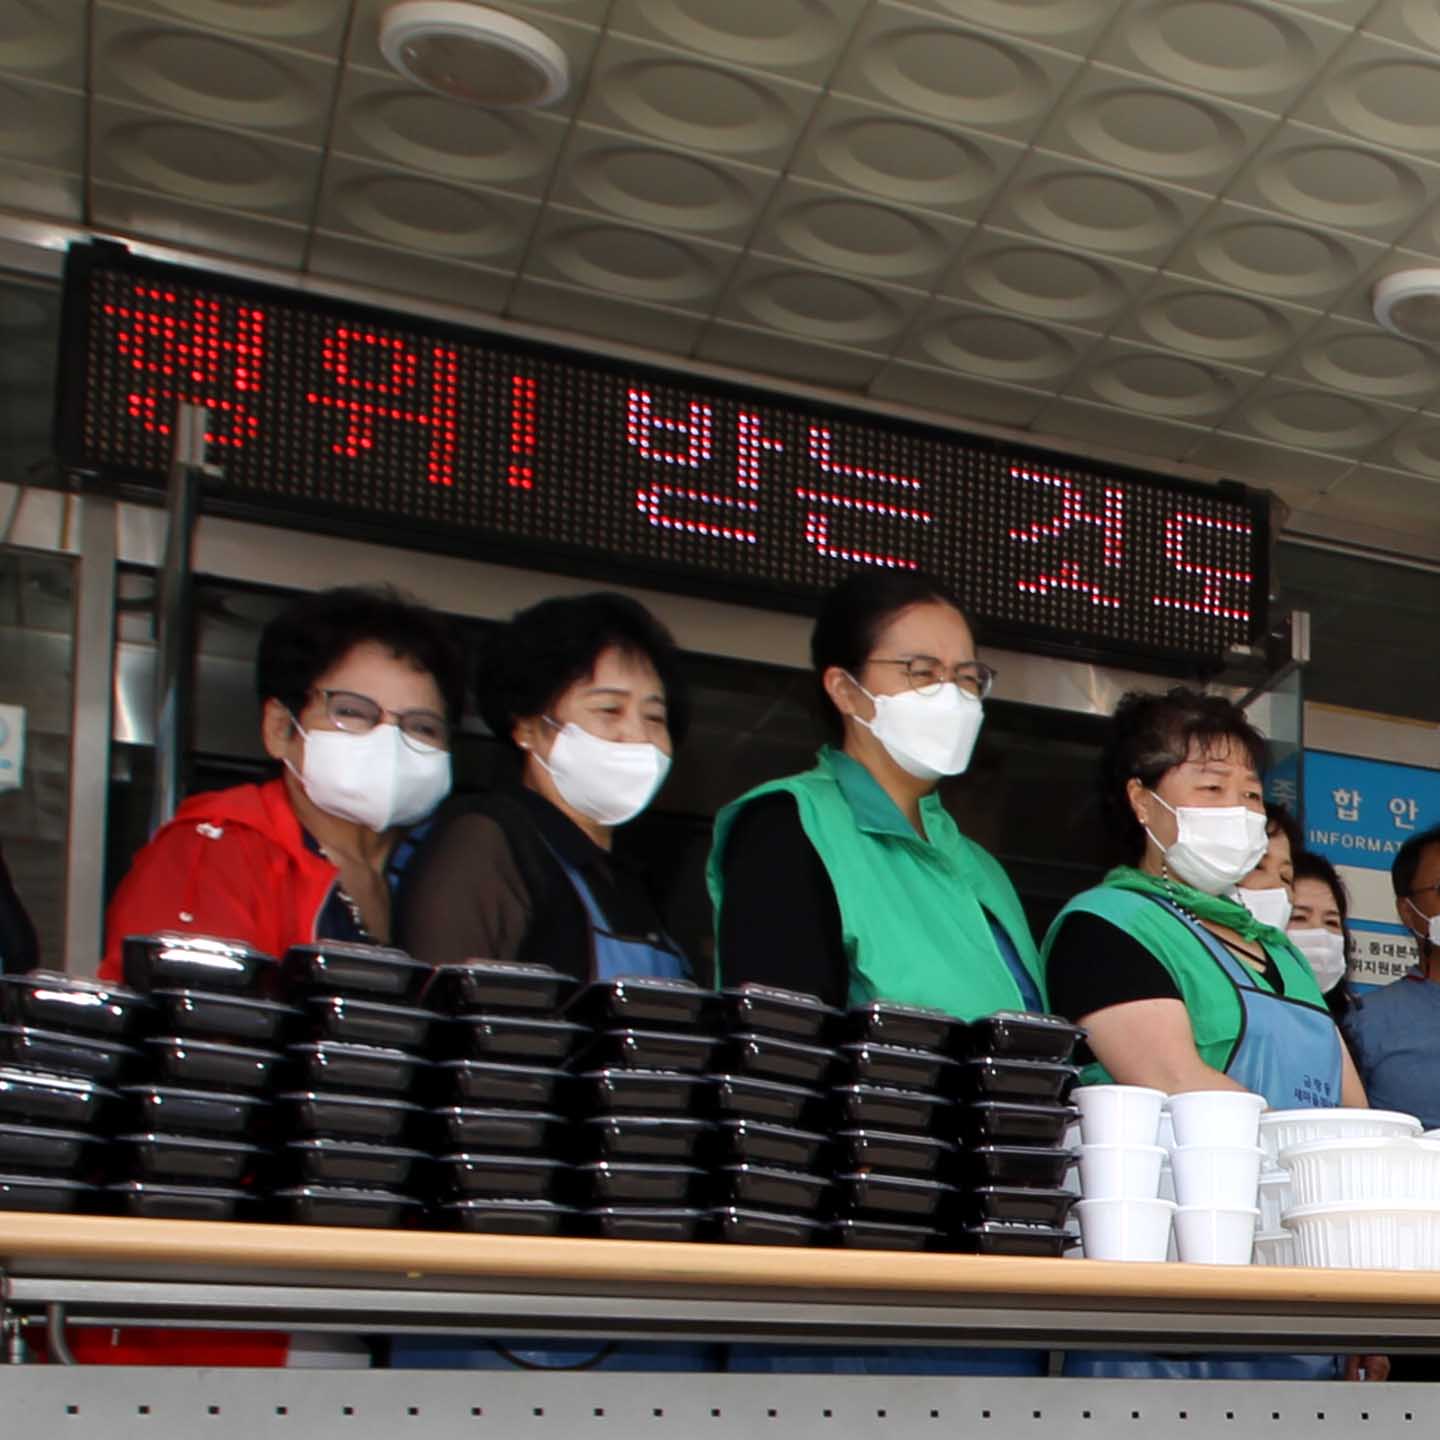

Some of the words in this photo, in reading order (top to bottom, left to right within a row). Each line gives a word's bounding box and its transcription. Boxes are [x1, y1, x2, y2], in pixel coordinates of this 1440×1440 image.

[104, 285, 537, 490] 행위!
[627, 387, 936, 573] 받는
[1309, 831, 1402, 853] INFORMAT
